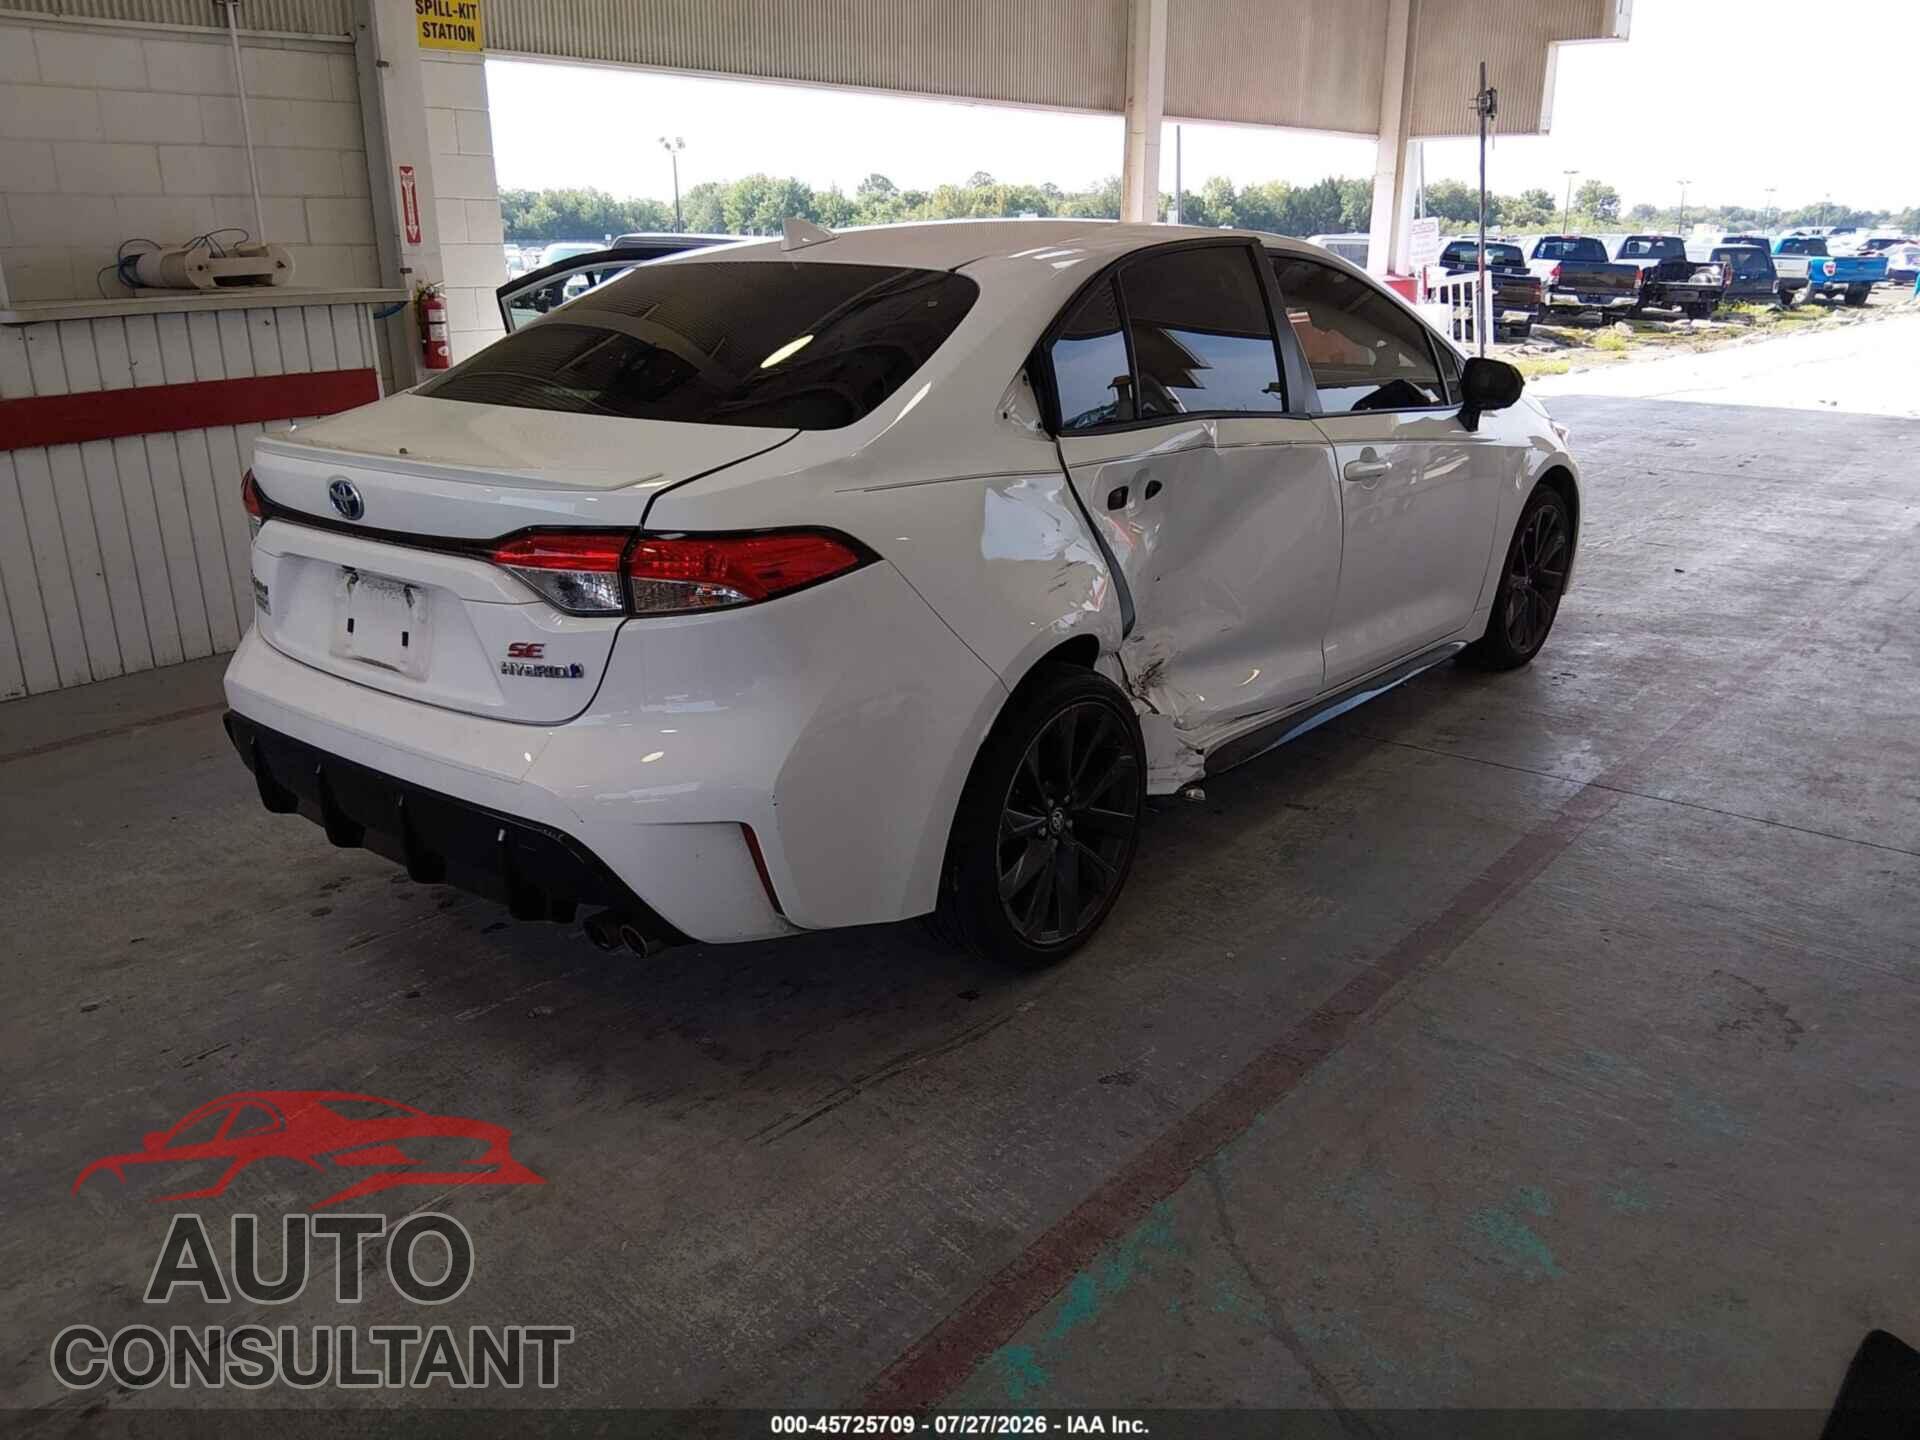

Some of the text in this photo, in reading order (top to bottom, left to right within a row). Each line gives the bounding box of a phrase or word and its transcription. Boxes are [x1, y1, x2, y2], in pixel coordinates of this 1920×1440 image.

[415, 0, 477, 20] SPILL-KIT
[422, 21, 476, 42] STATION
[507, 642, 545, 659] SE
[501, 661, 569, 678] HYBRID
